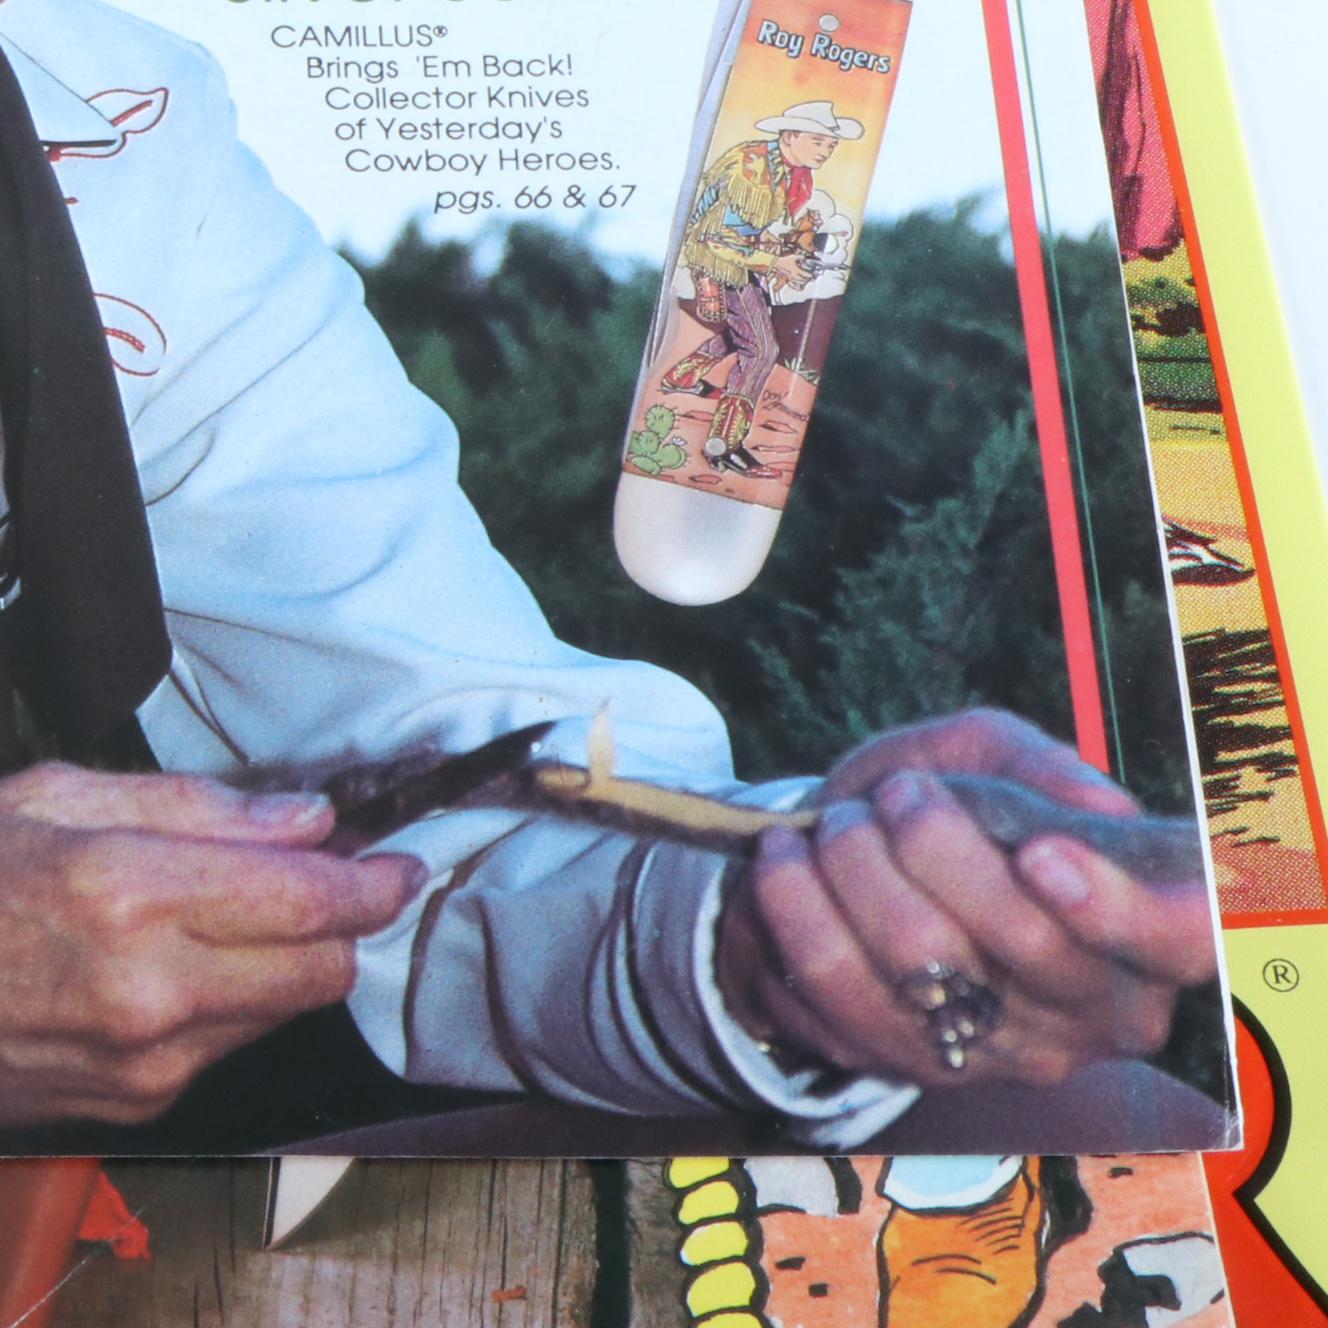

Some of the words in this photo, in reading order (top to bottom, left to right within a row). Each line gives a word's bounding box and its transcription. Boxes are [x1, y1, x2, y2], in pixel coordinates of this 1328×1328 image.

[757, 19, 805, 58] Roy
[810, 33, 892, 74] Rogers
[307, 56, 399, 84] Brings
[416, 55, 471, 78] 'Em
[482, 53, 573, 77] Back!
[324, 86, 477, 110] Collector
[487, 85, 590, 108] Knives
[334, 117, 367, 141] of
[376, 116, 563, 143] Yesterday's
[345, 149, 487, 176] Cowboy
[498, 148, 621, 172] Heroes.
[434, 189, 501, 214] pgs.
[513, 185, 553, 208] 66
[563, 185, 587, 208] &
[598, 184, 637, 208] 67
